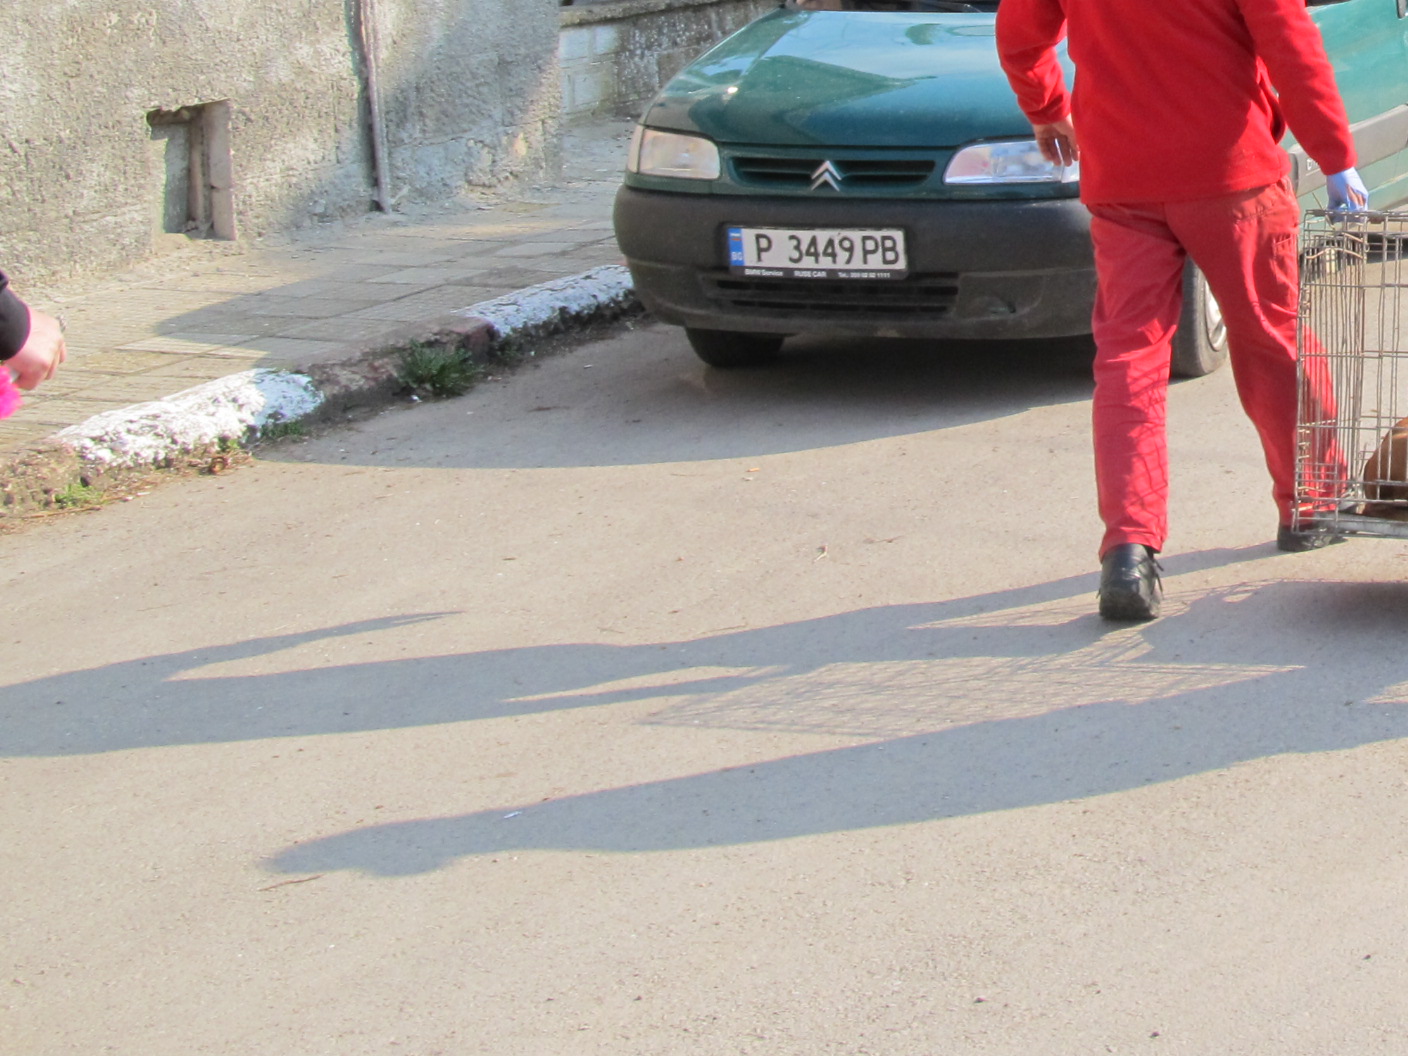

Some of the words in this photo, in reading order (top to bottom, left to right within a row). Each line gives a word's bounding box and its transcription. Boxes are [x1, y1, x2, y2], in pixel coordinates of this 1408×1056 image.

[732, 251, 743, 261] BG
[754, 233, 772, 263] P
[788, 234, 854, 265] 3449
[861, 235, 899, 265] PB
